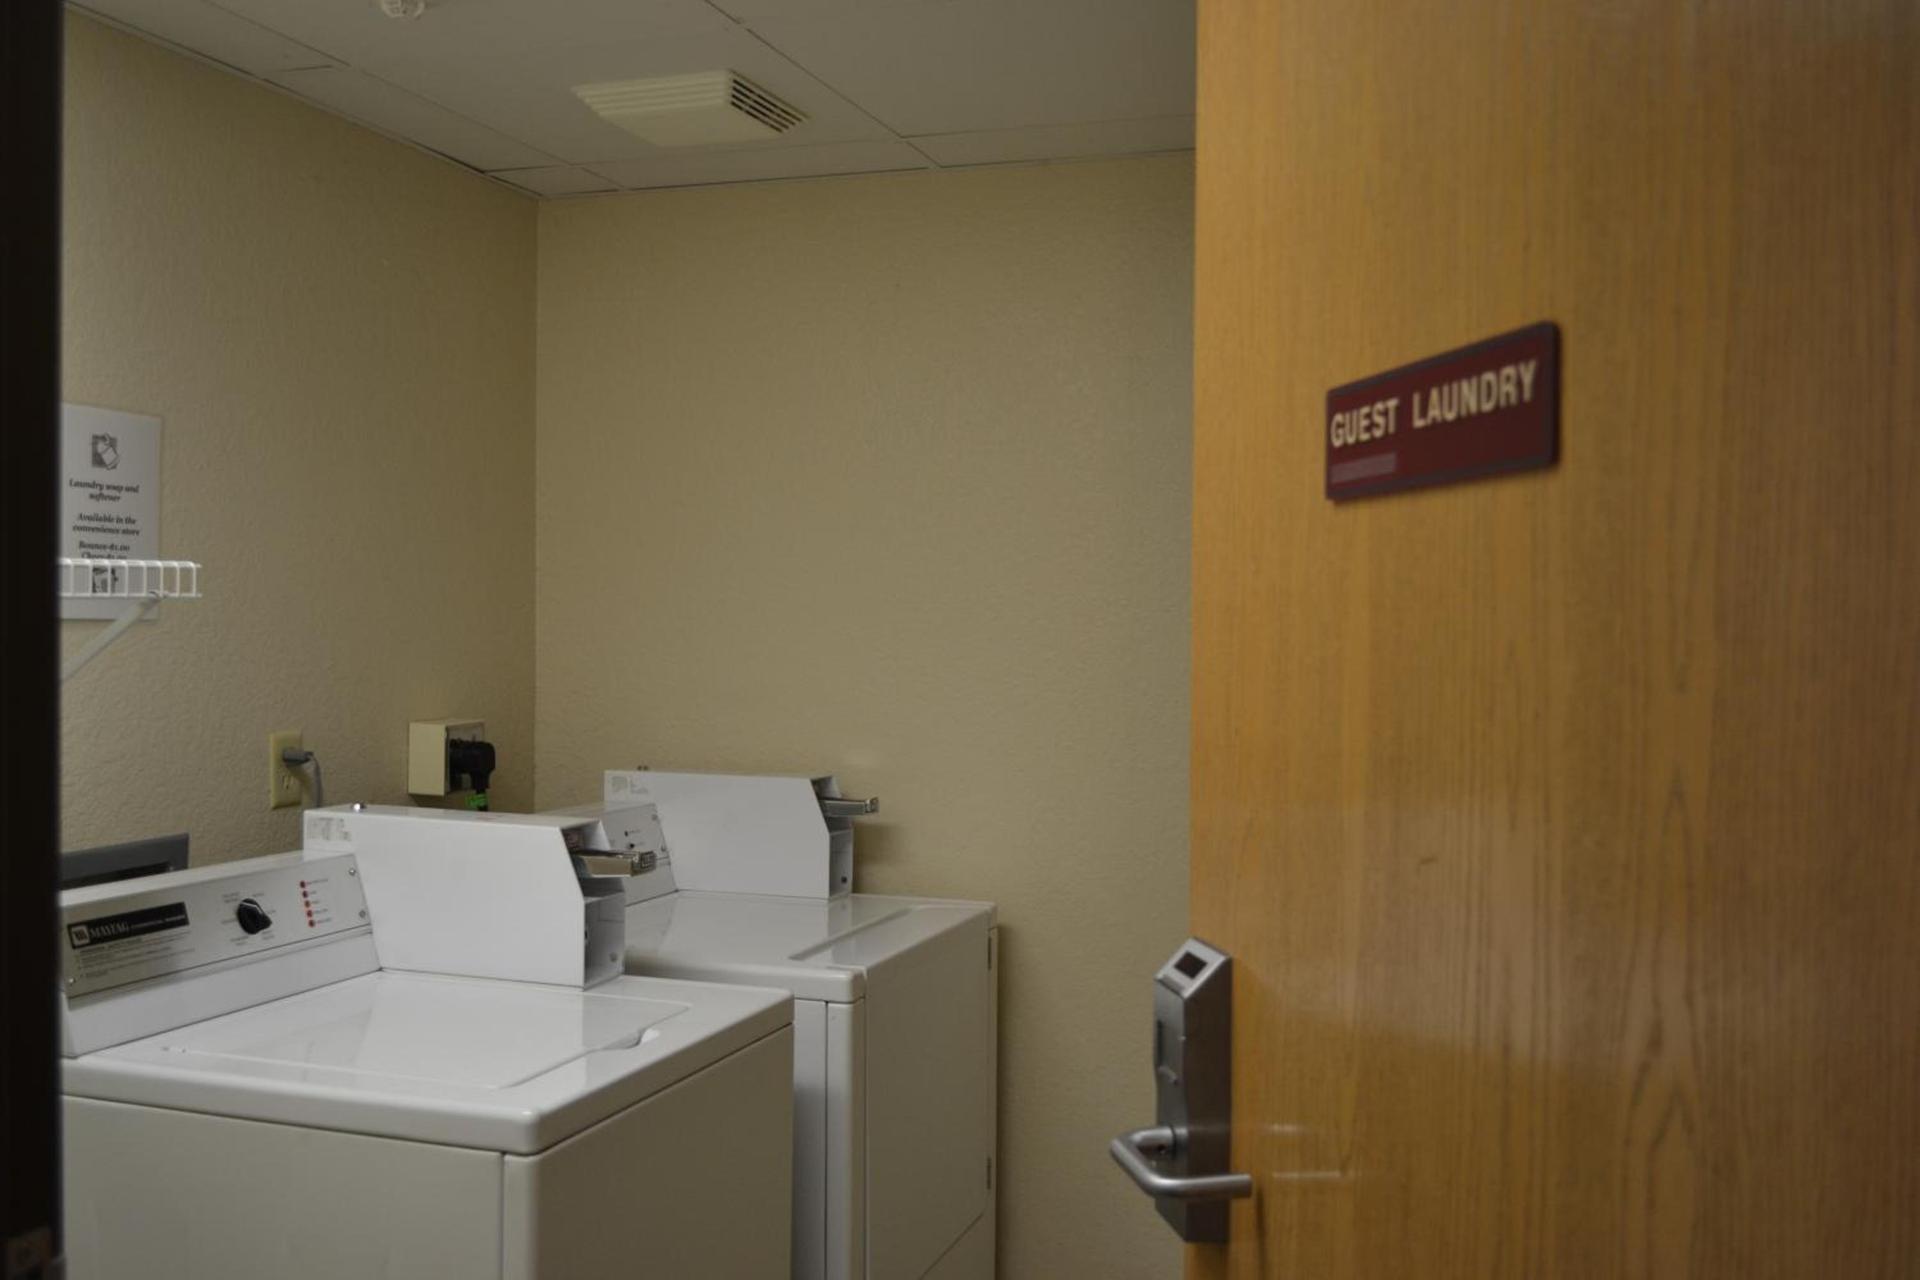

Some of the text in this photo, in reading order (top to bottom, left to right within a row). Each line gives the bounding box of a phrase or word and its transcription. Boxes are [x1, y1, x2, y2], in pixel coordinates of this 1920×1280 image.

[1330, 358, 1538, 448] GUEST LAUNDRY
[69, 478, 104, 491] Laundry
[125, 484, 140, 493] and
[78, 513, 114, 523] Available
[125, 515, 136, 524] the
[73, 525, 119, 534] convenience
[89, 920, 129, 939] MAYTAG
